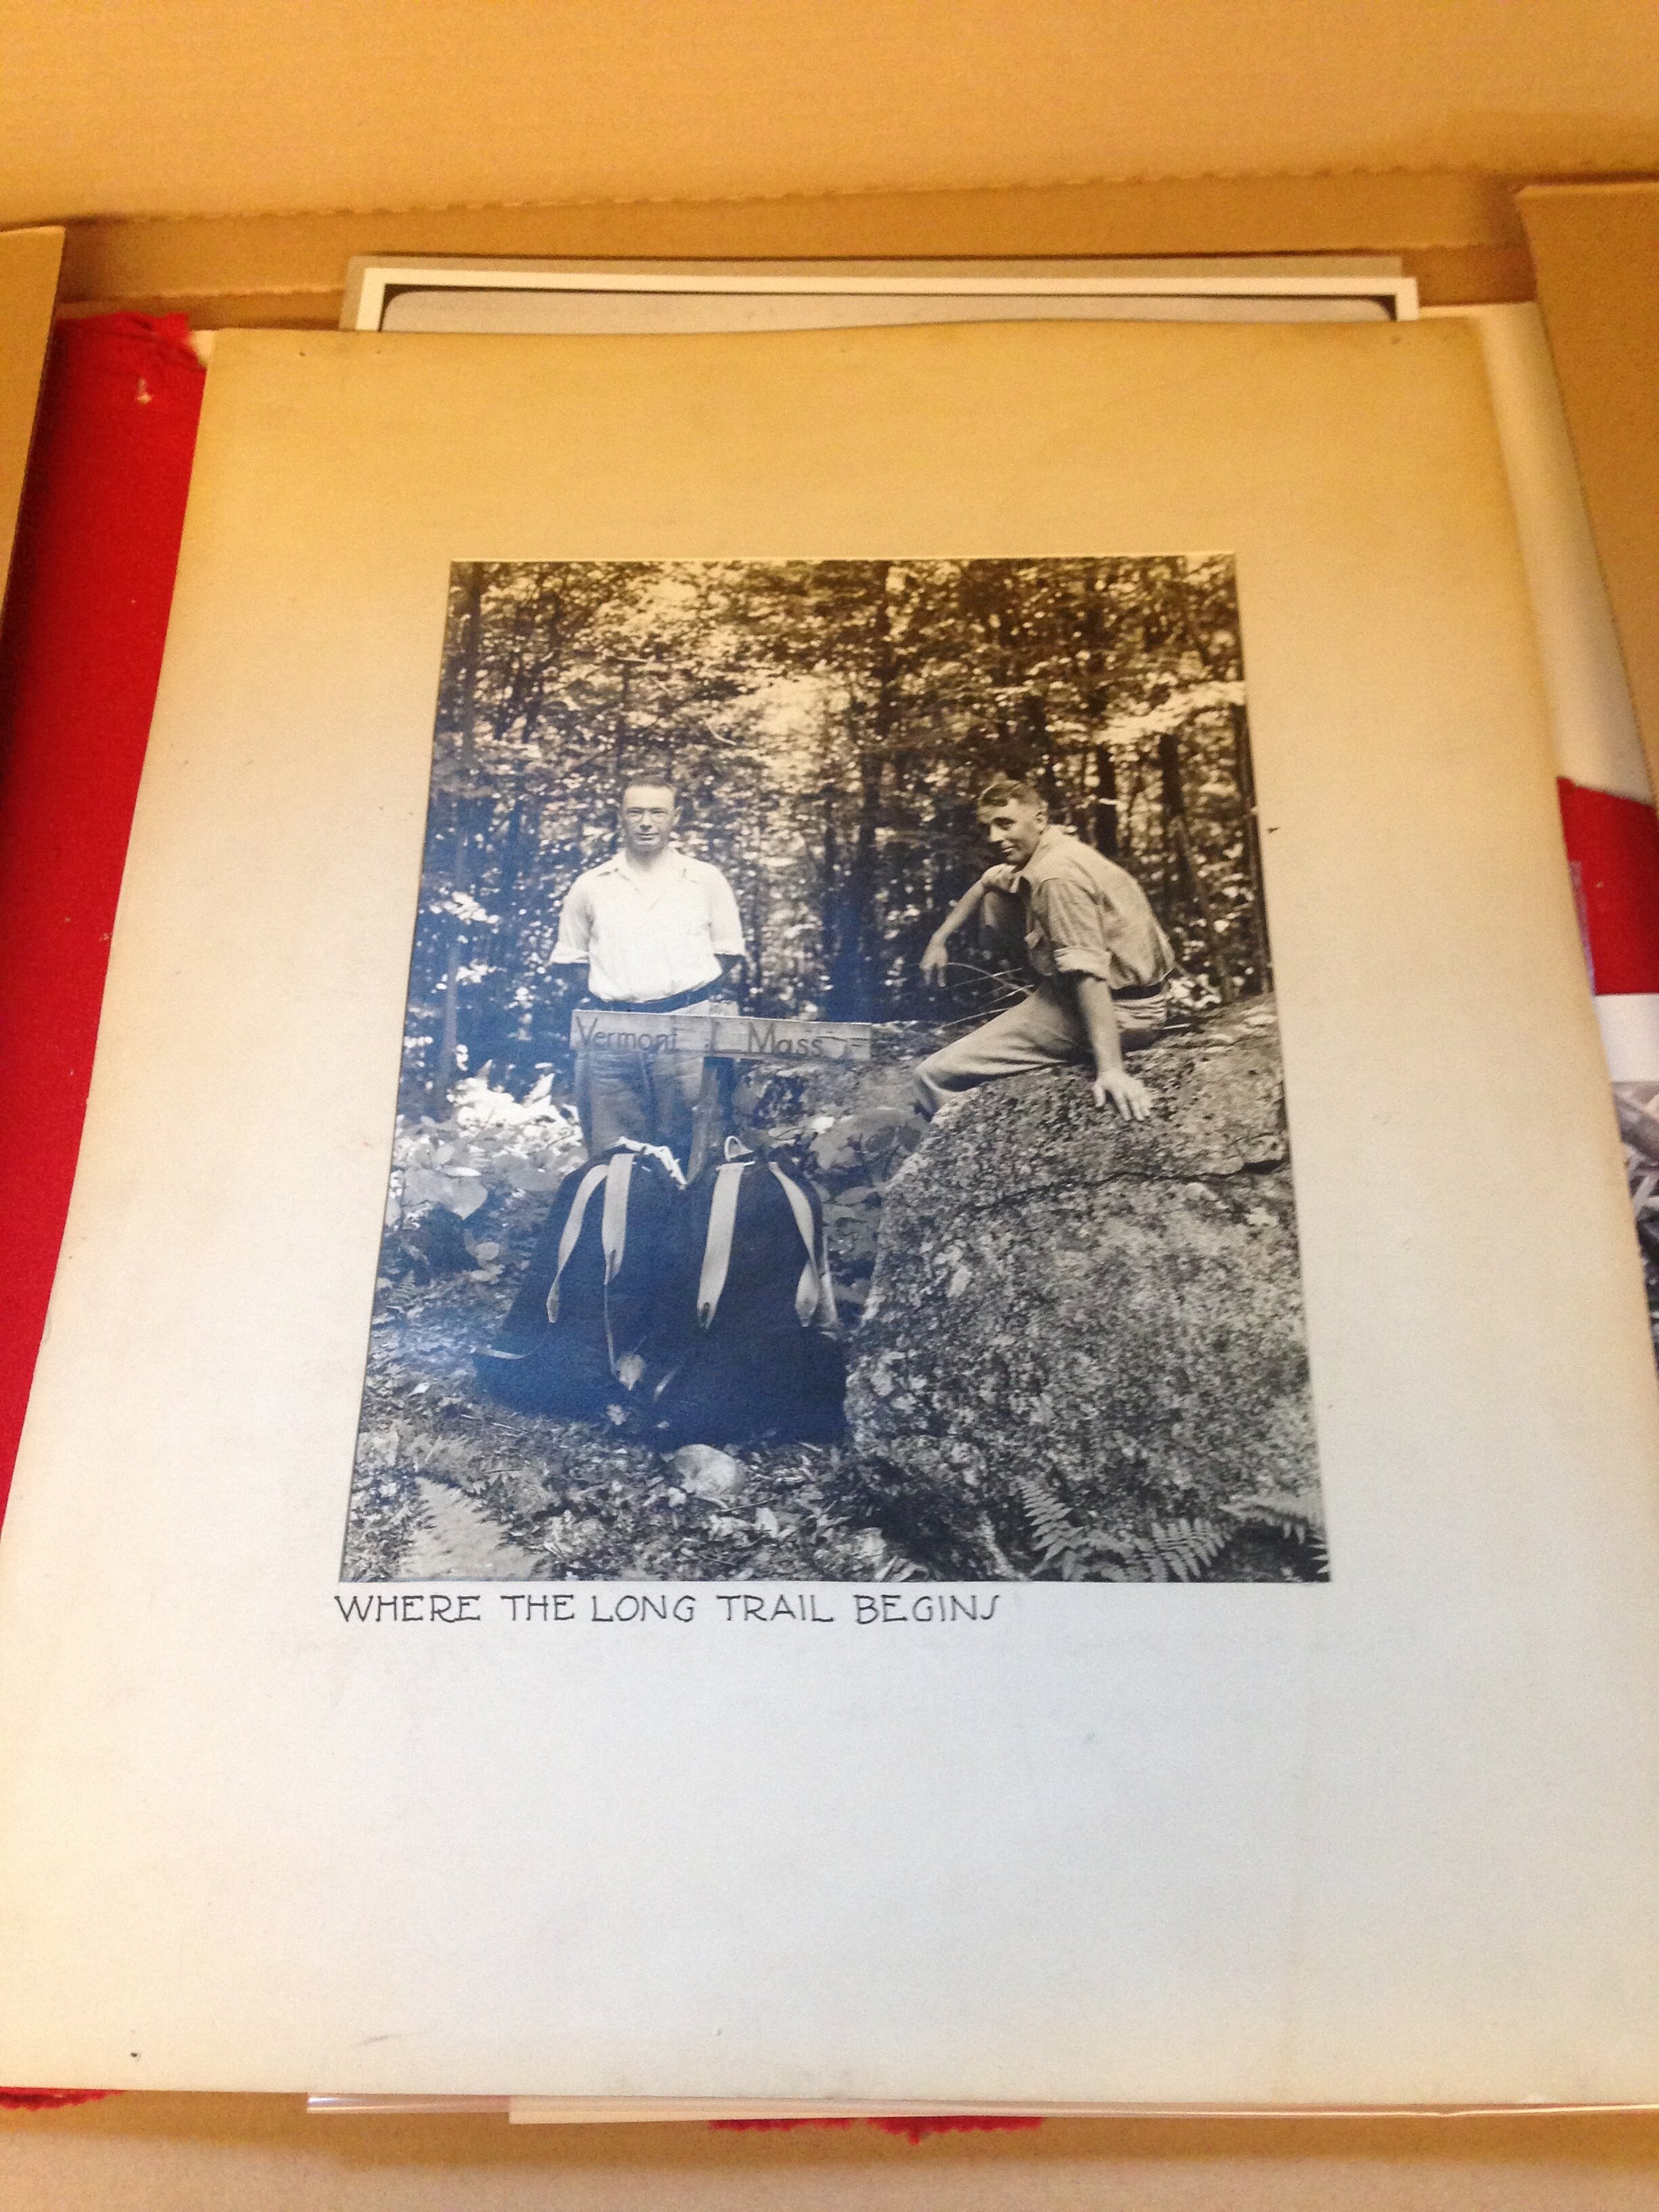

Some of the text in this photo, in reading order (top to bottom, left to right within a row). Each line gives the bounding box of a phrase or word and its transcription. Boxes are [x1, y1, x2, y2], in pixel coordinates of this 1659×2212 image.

[576, 1016, 679, 1051] Vermont
[333, 1593, 1002, 1625] WHERE THE LONG TRAIL BEGINS
